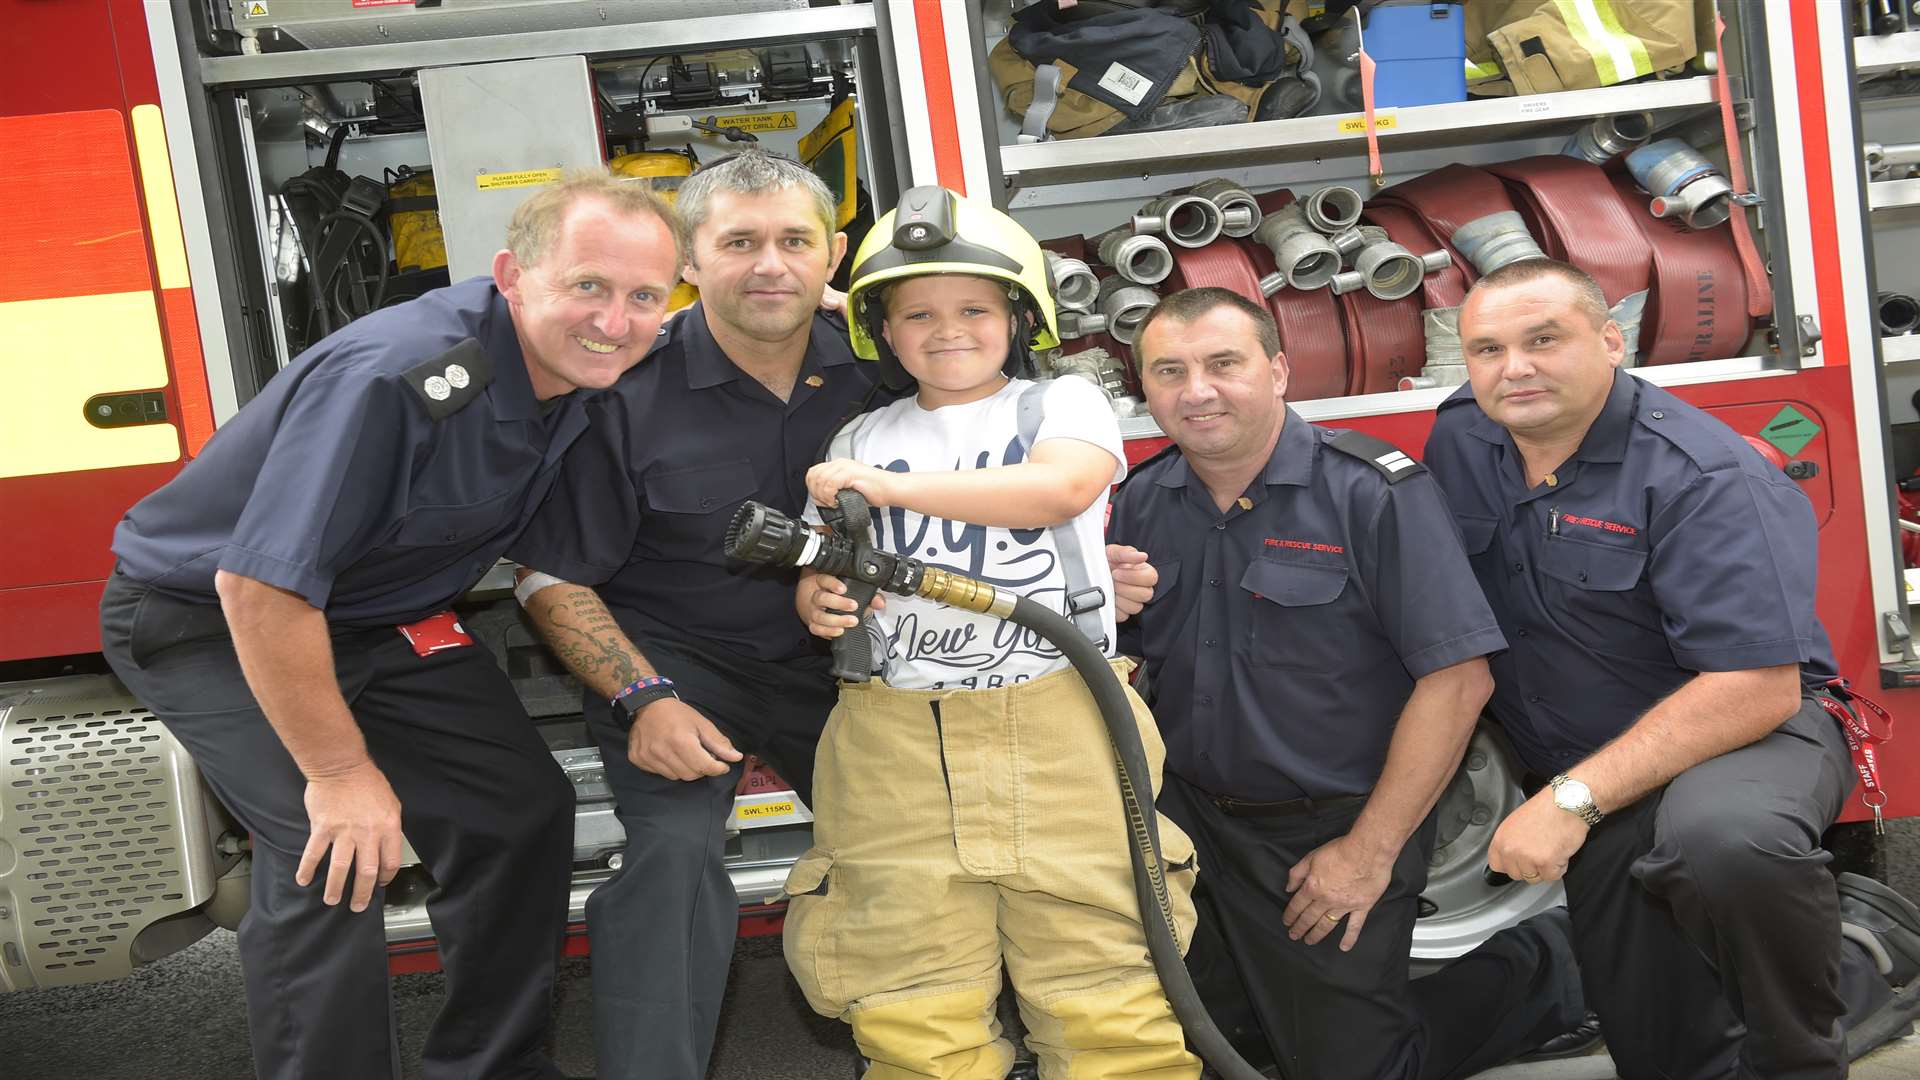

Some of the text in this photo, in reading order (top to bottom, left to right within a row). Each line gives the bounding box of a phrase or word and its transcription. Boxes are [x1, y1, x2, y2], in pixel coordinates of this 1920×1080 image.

[722, 115, 772, 125] WATER TANK
[1345, 121, 1366, 129] SWL
[1604, 521, 1637, 535] SERVICE
[1284, 541, 1311, 549] RESCUE
[1312, 544, 1344, 554] SERVICE
[888, 613, 978, 662] New
[1846, 719, 1870, 739] STAFF
[1858, 764, 1875, 788] STAFF
[743, 804, 791, 816] SWL 115KG
